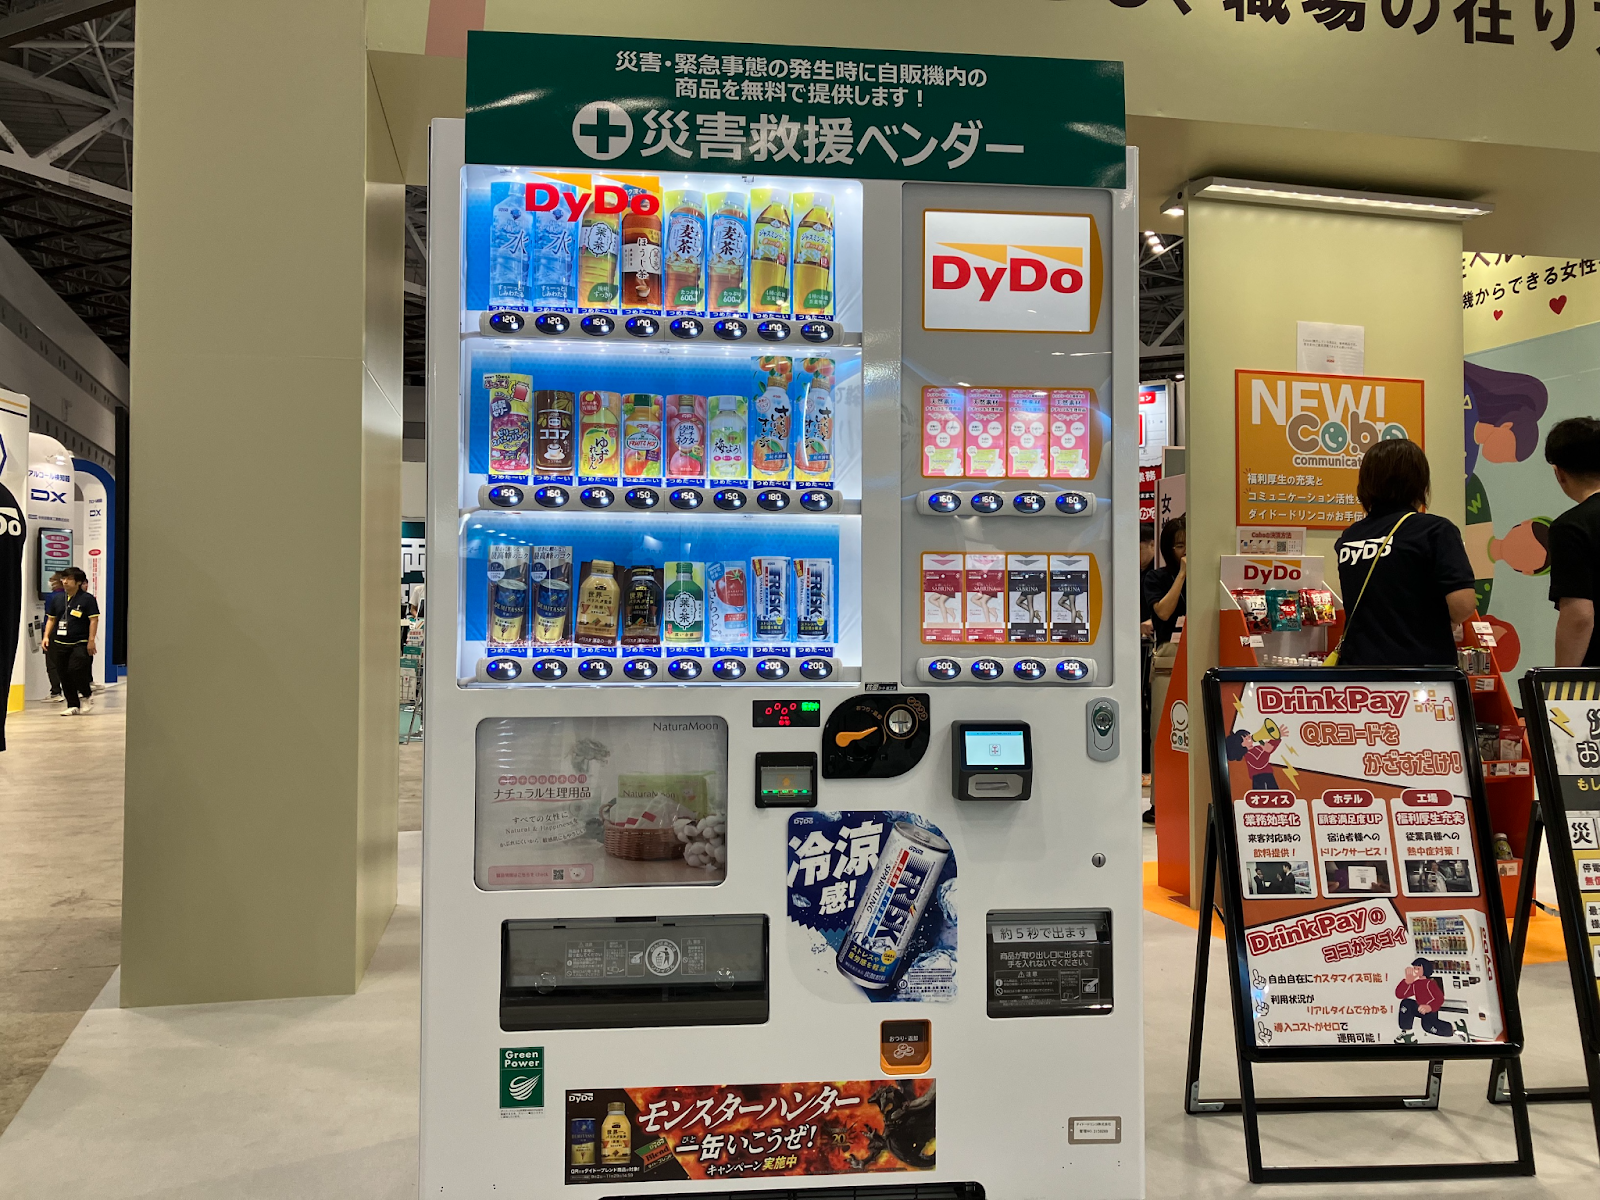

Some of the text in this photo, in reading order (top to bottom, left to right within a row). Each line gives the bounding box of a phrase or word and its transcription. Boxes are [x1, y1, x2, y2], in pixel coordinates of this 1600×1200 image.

[615, 50, 987, 87] 災害・緊急事態の発生時に自販機内の
[640, 109, 1024, 169] 災害救援ベンダー
[525, 183, 659, 222] DyDo
[503, 230, 529, 254] 水
[546, 230, 571, 254] 水
[677, 224, 695, 254] 麦茶
[720, 226, 738, 255] 麦茶
[801, 232, 830, 245] ジャスミンティー
[637, 237, 649, 279] ほうじ茶
[932, 255, 1083, 301] DyDo
[1463, 258, 1600, 309] からできる女性
[637, 319, 650, 327] 170
[769, 323, 782, 331] 170
[1251, 379, 1386, 430] NEW!
[492, 431, 529, 447] スパークリング
[540, 429, 570, 439] ココア
[758, 417, 770, 448] オレンジ
[675, 437, 699, 446] ネクター
[588, 437, 609, 470] ゆず れもん
[28, 470, 70, 483] アルコール検知器
[1247, 473, 1323, 486] 福利厚生の充実と
[31, 488, 67, 504] DX
[592, 490, 606, 498] 150
[637, 491, 650, 499] 150
[725, 492, 738, 500] 150
[768, 493, 782, 501] 180
[1066, 496, 1079, 504] 160
[89, 509, 102, 517] DX
[1244, 565, 1302, 584] DyDo
[769, 571, 781, 614] FRISK
[810, 572, 822, 615] FRISK
[679, 596, 691, 623] 葉の茶
[1257, 686, 1410, 718] DrinkPay
[653, 722, 719, 732] NaturaMoon
[1300, 721, 1400, 746] QRコードを
[1363, 749, 1463, 776] かざすだけ!
[493, 787, 591, 800] ナチュラル生理用品
[1250, 794, 1290, 805] オフィス
[1333, 793, 1363, 804] ホテル
[1417, 792, 1438, 804] 工場
[512, 811, 569, 825] すべての女性に
[1244, 812, 1301, 827] 業務効率化
[1318, 812, 1383, 825] 顧客満足度UP
[1396, 811, 1465, 826] 福利厚生充実
[505, 825, 530, 834] Natural
[1327, 832, 1380, 842] 宿泊者様への
[1405, 831, 1460, 842] 従業員様への
[1571, 822, 1593, 844] 災
[1247, 833, 1301, 843] 来客対応時の
[787, 820, 884, 888] 冷涼
[866, 863, 892, 914] SPARKLING
[819, 879, 857, 915] 感!
[1246, 907, 1387, 957] DrinkPayの
[1321, 926, 1408, 963] ココがスゴイ
[851, 945, 880, 962] ストレスや
[1000, 950, 1093, 961] 商品が取り出し口に出るまで
[848, 952, 885, 972] 疲労感を軽減
[1007, 958, 1089, 968] 手を入れないでください。
[1268, 973, 1389, 984] 自由自在にカスタマイズ可能！
[1270, 994, 1315, 1004] 利用状況が
[1273, 1022, 1349, 1033] 導入コストがゼロで
[505, 1050, 539, 1059] Green
[504, 1059, 540, 1068] Power
[568, 1095, 594, 1103] DyDo
[638, 1085, 861, 1133] モンスターハンター
[675, 1124, 818, 1162] 一缶いこうぜ!
[682, 1135, 697, 1144] ひと
[832, 1133, 846, 1145] 20
[645, 1147, 669, 1162] Blend
[706, 1155, 798, 1175] キャンペーン実施中
